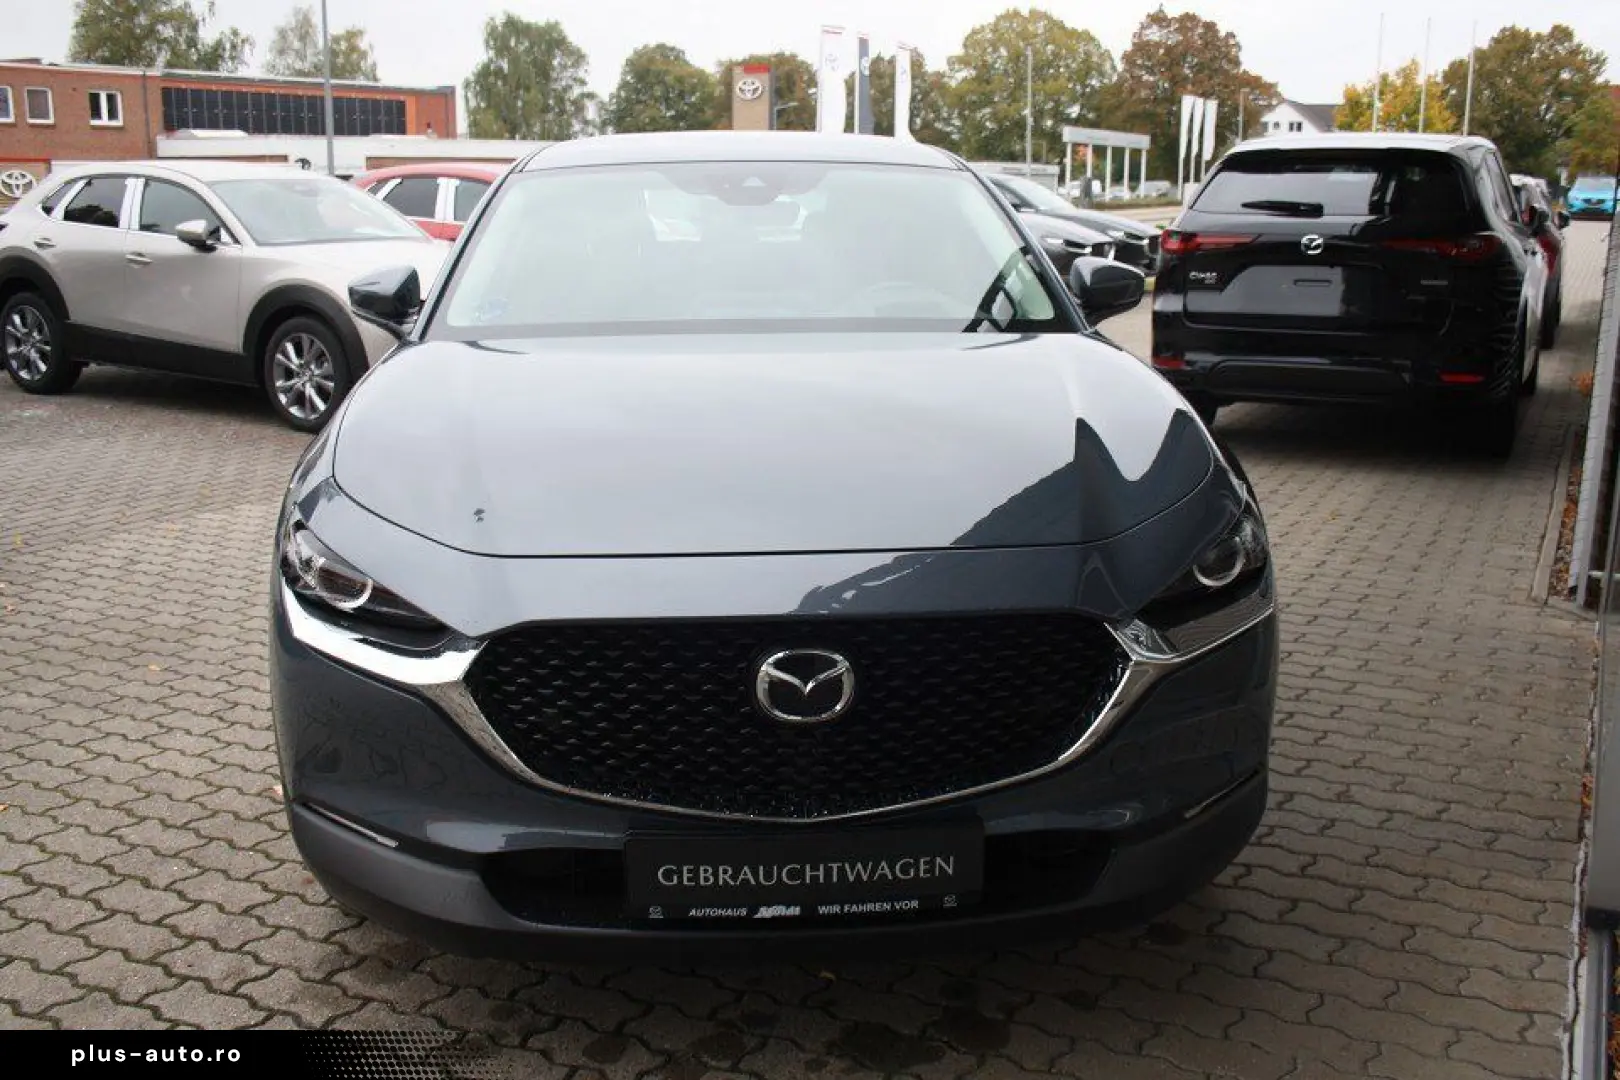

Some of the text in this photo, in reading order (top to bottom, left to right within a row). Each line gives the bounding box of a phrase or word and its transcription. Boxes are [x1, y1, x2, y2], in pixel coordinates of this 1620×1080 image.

[657, 856, 955, 886] GEBRAUCHTWAGEN
[688, 906, 748, 918] AUTOHAUS
[818, 900, 919, 915] WIR FAHREN VOR
